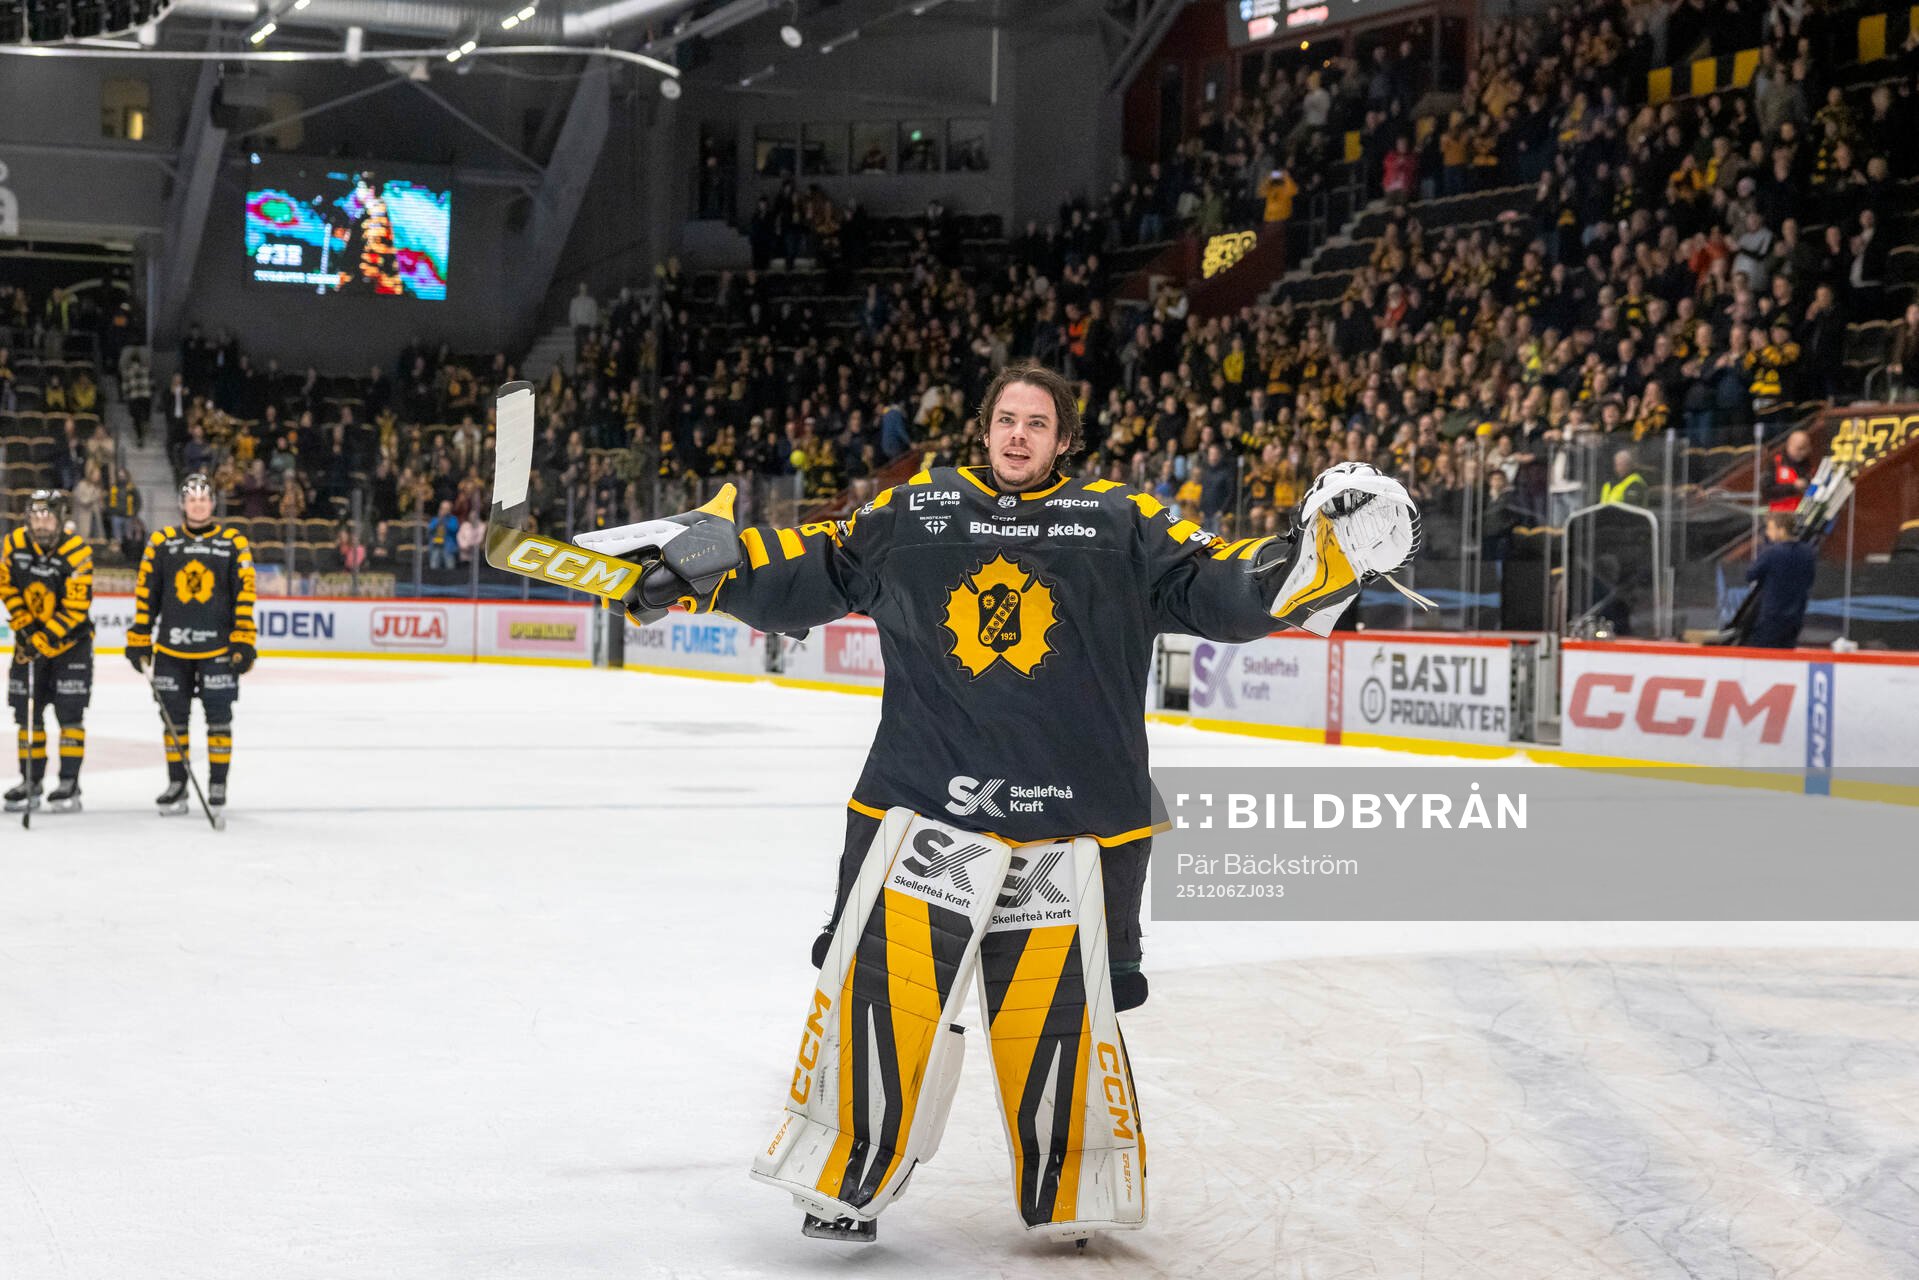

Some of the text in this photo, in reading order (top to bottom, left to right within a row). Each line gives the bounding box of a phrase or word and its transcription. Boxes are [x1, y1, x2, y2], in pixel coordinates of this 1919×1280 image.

[926, 491, 961, 501] LEAB
[1045, 498, 1100, 509] engcon
[969, 521, 1040, 537] BOLIDEN
[1047, 523, 1097, 538] skebo
[507, 538, 634, 594] CCM
[259, 611, 335, 639] IDEN
[374, 614, 444, 640] JULA
[1000, 631, 1017, 641] 1921
[671, 623, 739, 657] FUMEX
[1390, 652, 1489, 696] BASTU
[1241, 680, 1271, 701] Kraft
[1389, 697, 1507, 733] PRODUKTER
[1567, 671, 1798, 745] CCM
[1811, 670, 1830, 774] CCM
[1009, 785, 1073, 800] Skellefteå
[1009, 800, 1044, 813] Kraft
[893, 874, 972, 909] Skellefteå Kraft
[991, 908, 1073, 925] Skellefteå Kraft
[790, 987, 832, 1106] CCM
[1097, 1041, 1134, 1141] CCM
